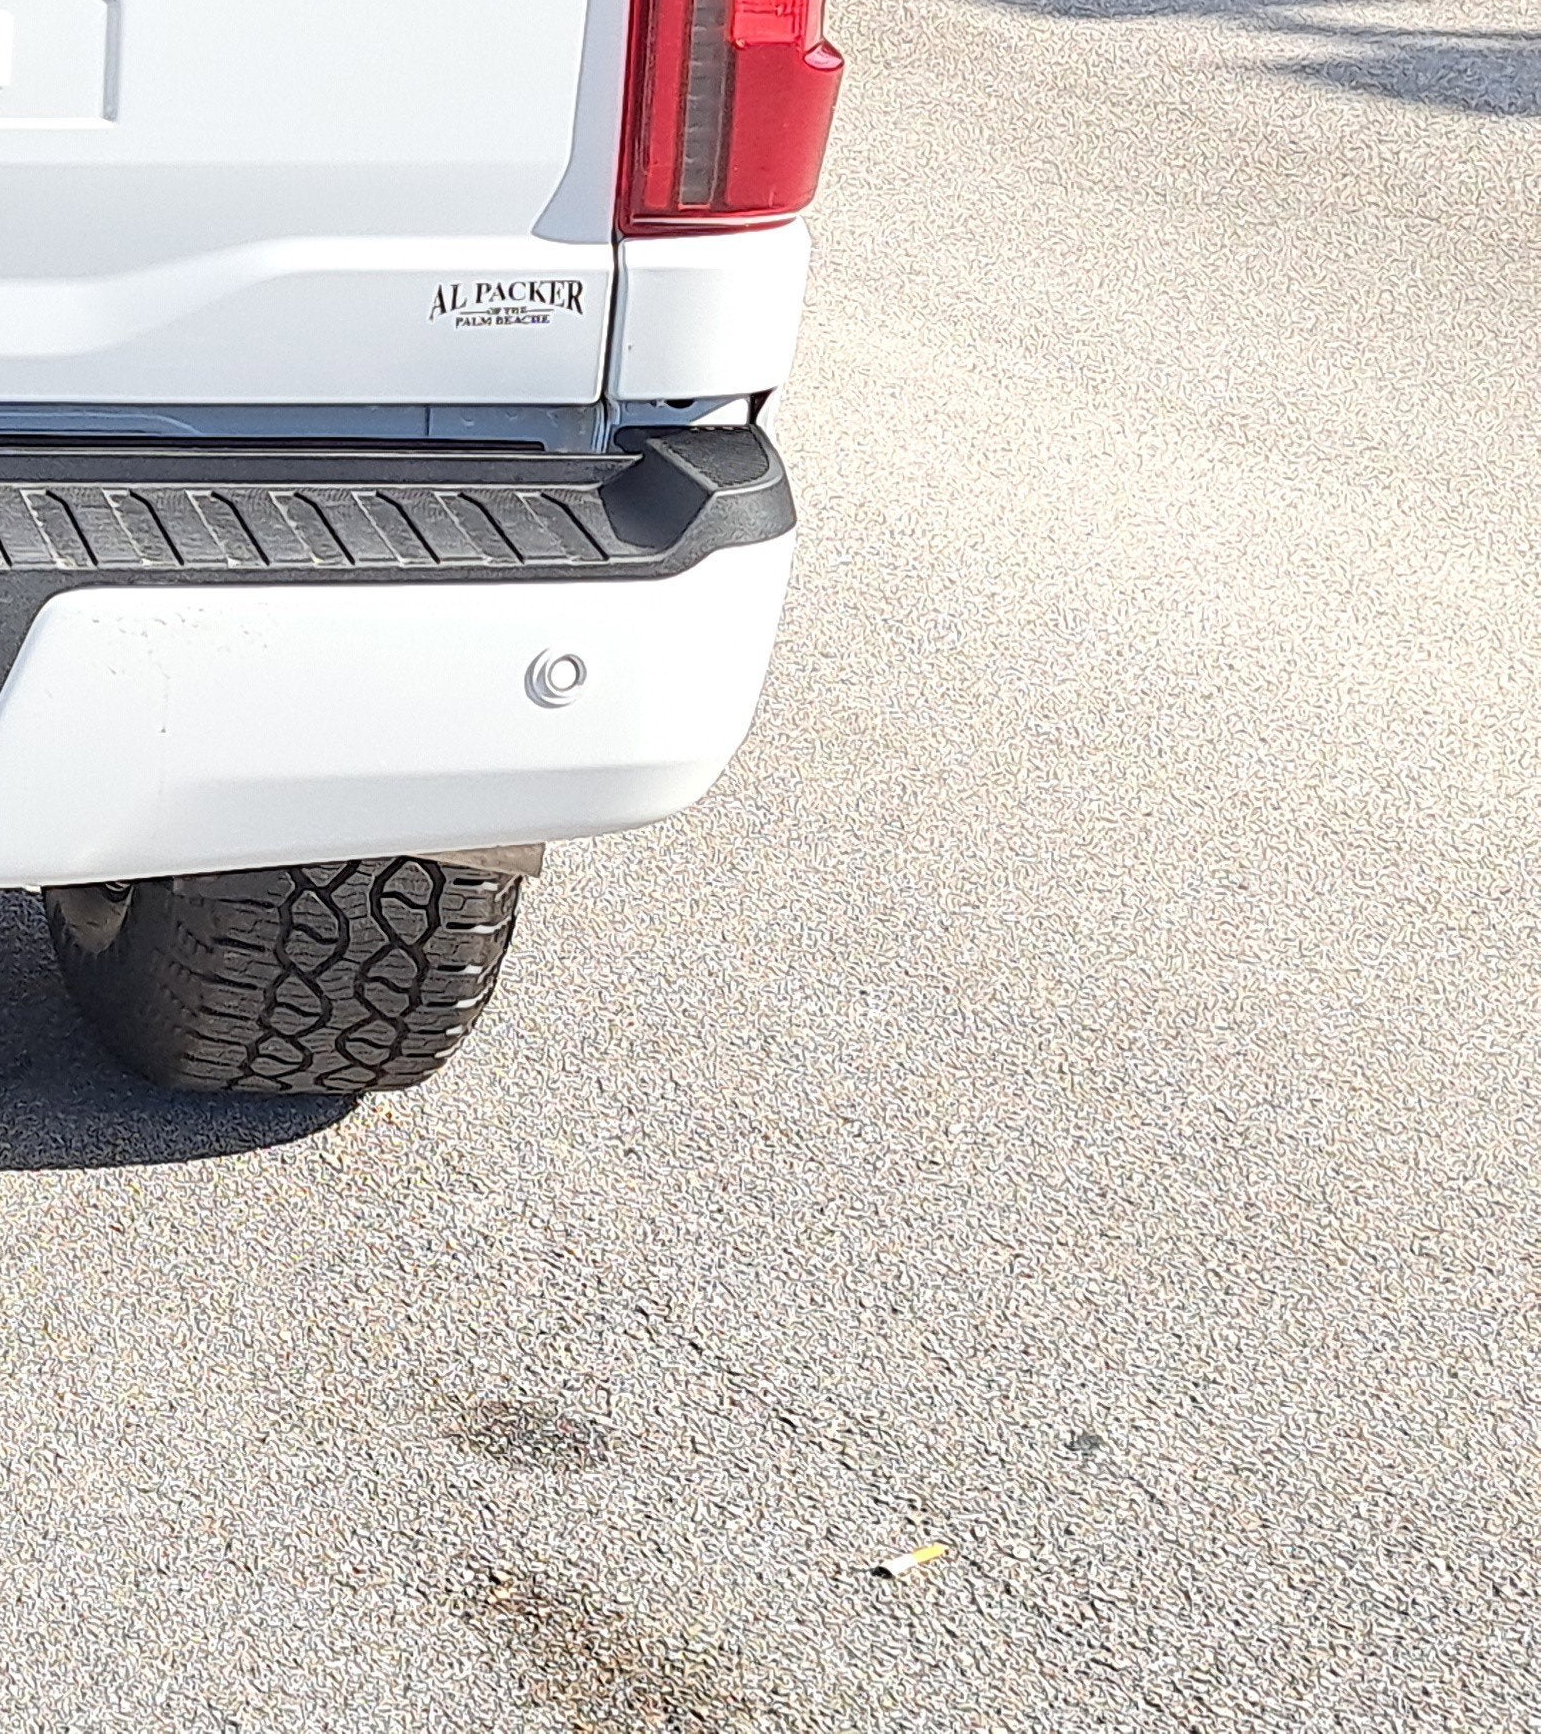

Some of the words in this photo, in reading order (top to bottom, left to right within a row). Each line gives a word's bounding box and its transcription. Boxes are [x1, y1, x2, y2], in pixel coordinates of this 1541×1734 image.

[429, 284, 468, 323] AL
[475, 280, 583, 316] PACKER
[455, 316, 492, 328] PALM
